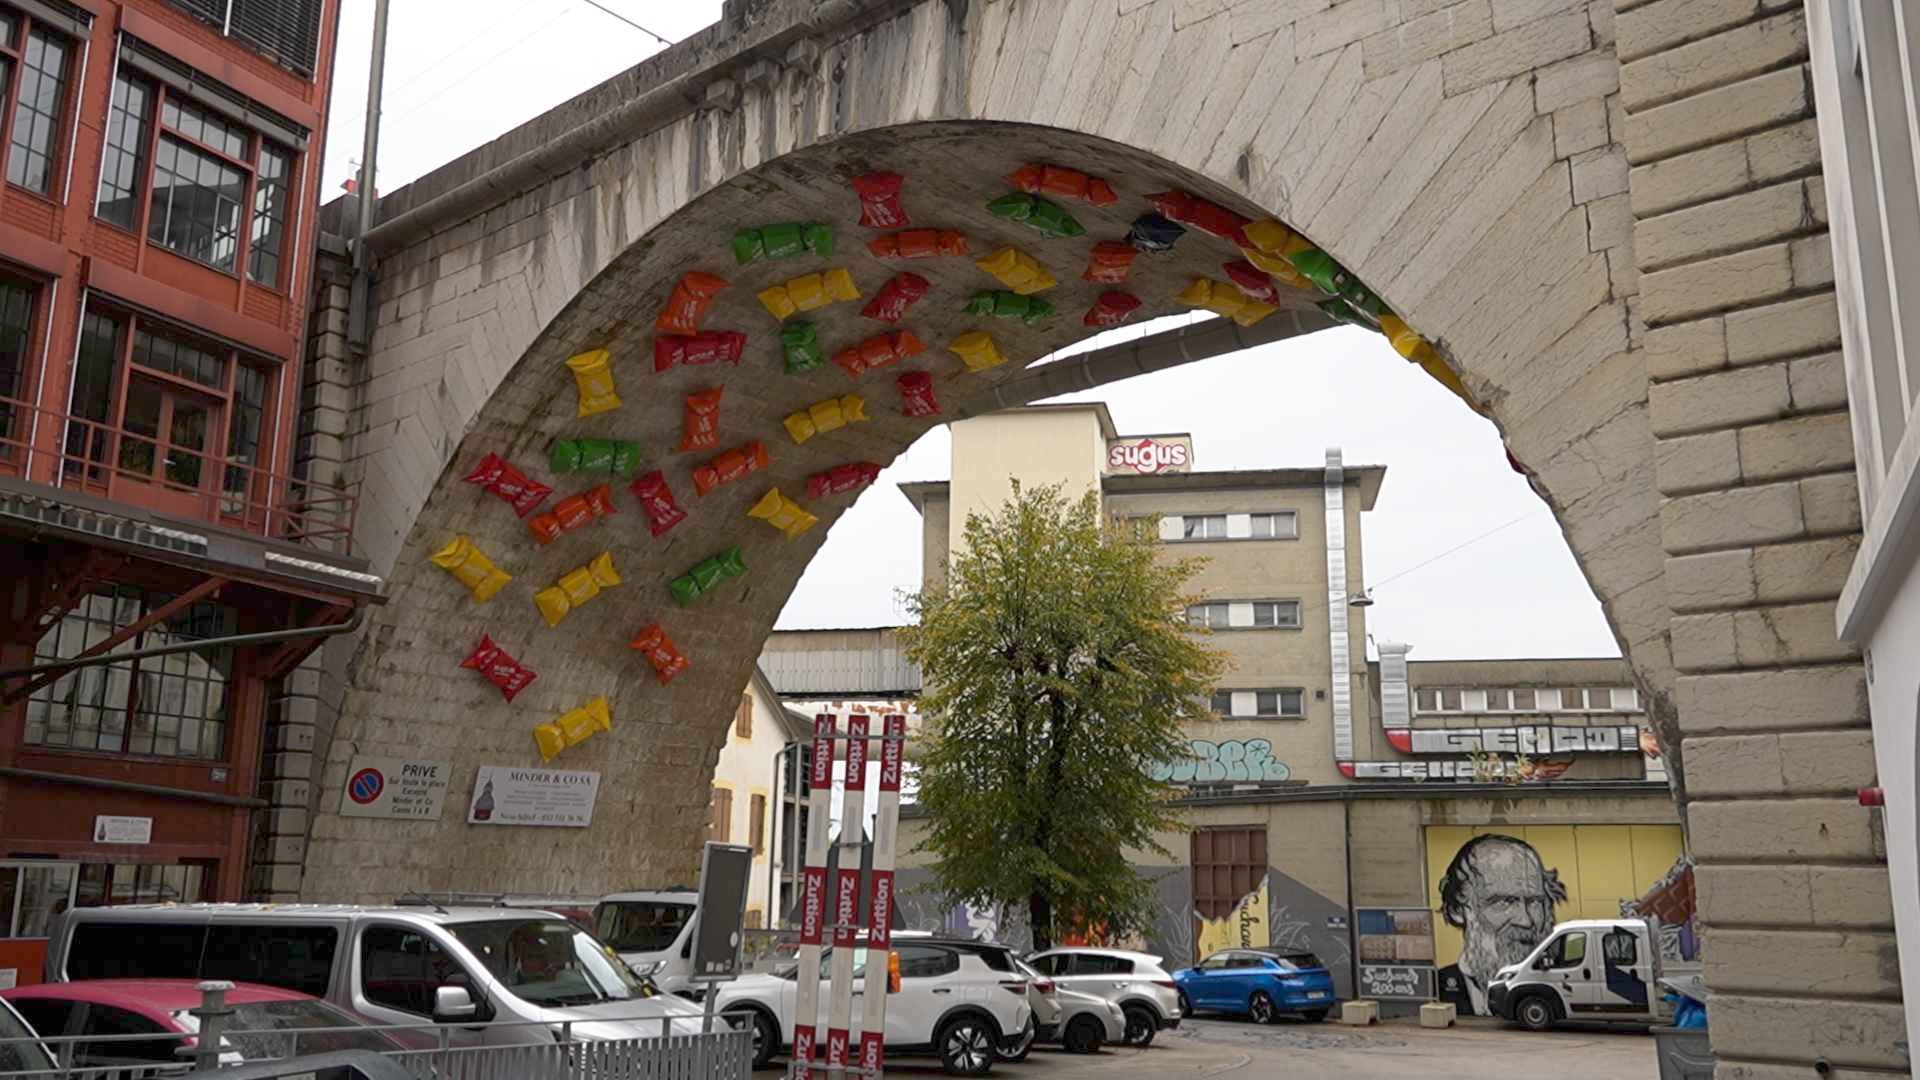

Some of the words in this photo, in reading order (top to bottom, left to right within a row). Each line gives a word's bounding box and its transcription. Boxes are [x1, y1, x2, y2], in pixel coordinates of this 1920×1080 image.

[1109, 443, 1186, 474] sugus
[402, 764, 438, 778] PRIVE
[804, 874, 821, 937] Zuttion
[837, 877, 855, 939] Zuttion
[871, 878, 889, 942] Zuttion
